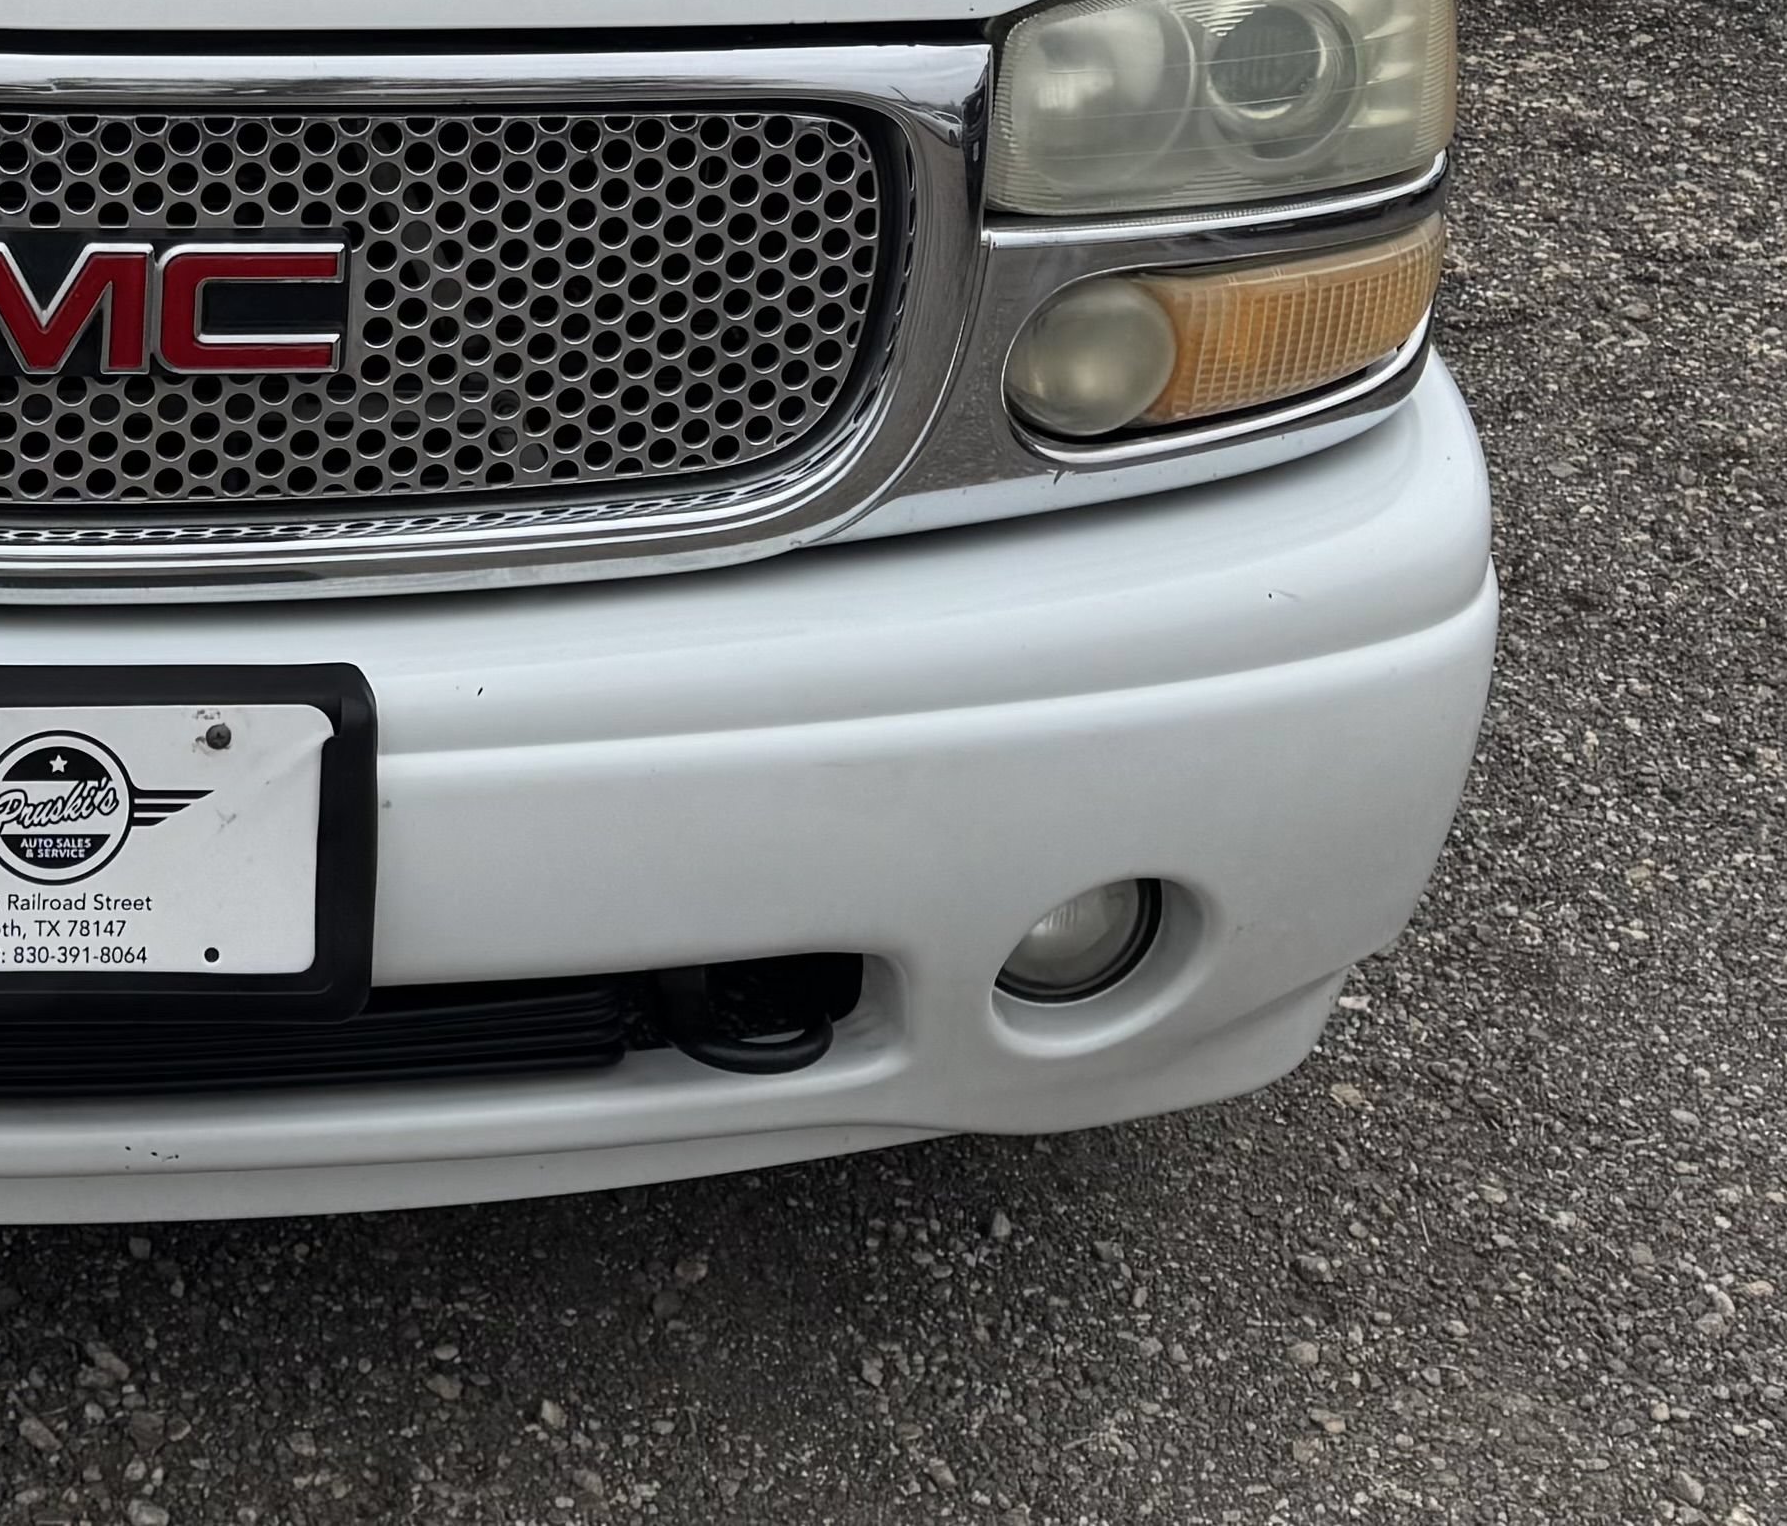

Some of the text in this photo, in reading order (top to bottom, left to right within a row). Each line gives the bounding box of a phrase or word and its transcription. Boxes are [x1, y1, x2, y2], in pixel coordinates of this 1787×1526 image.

[20, 837, 92, 849] AUTO SALES
[37, 848, 86, 859] SERVICE
[7, 892, 87, 911] Railroad
[93, 893, 153, 911] Street
[34, 919, 61, 937] TX
[67, 919, 127, 938] 78147
[13, 946, 148, 964] 830-391-8064
